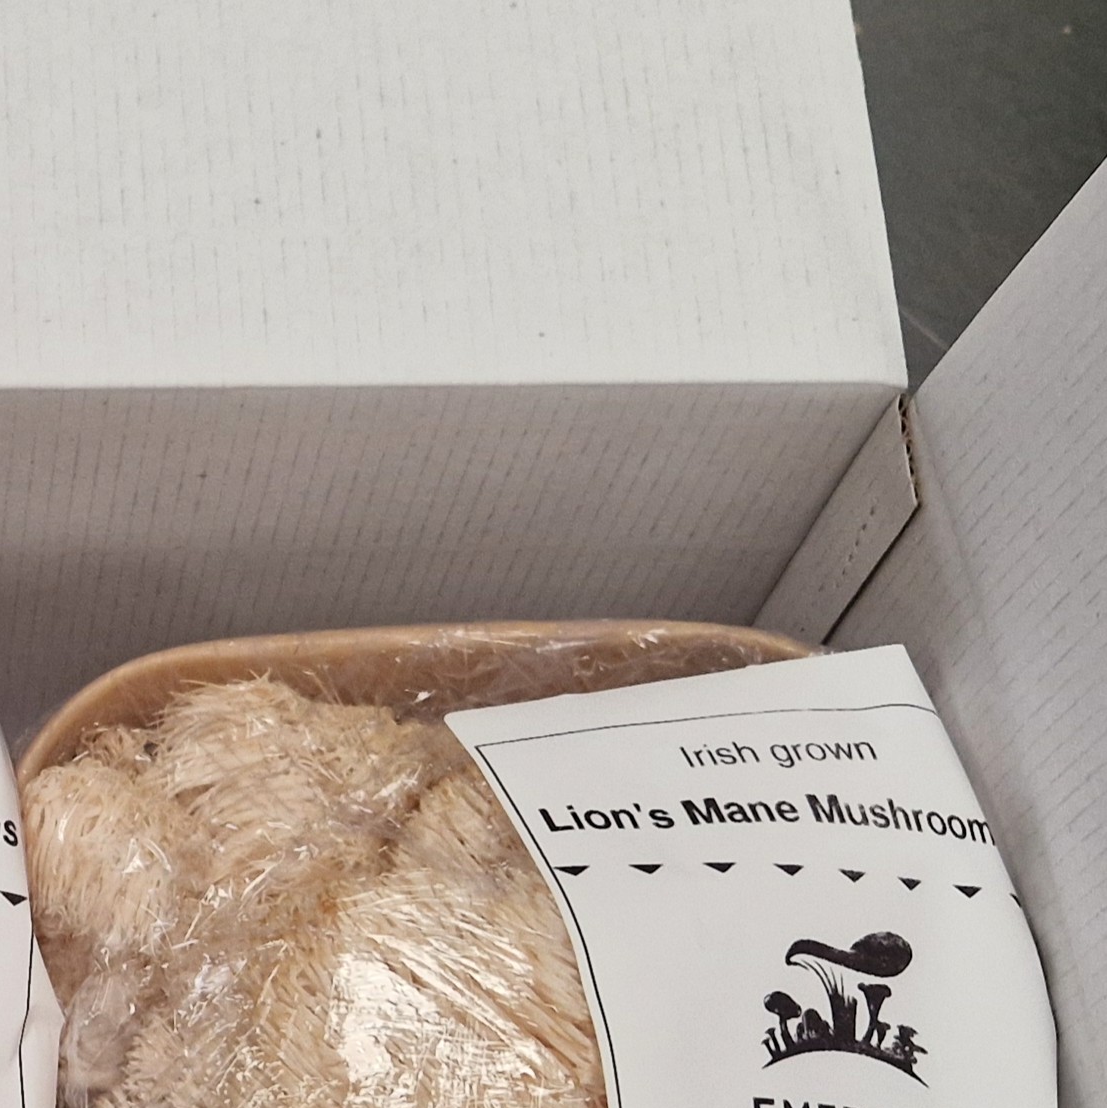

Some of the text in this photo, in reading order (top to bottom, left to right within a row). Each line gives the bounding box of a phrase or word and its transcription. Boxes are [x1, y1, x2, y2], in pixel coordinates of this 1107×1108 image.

[678, 737, 878, 769] Irish grown
[537, 793, 996, 846] Lion's Mane Mushroom
